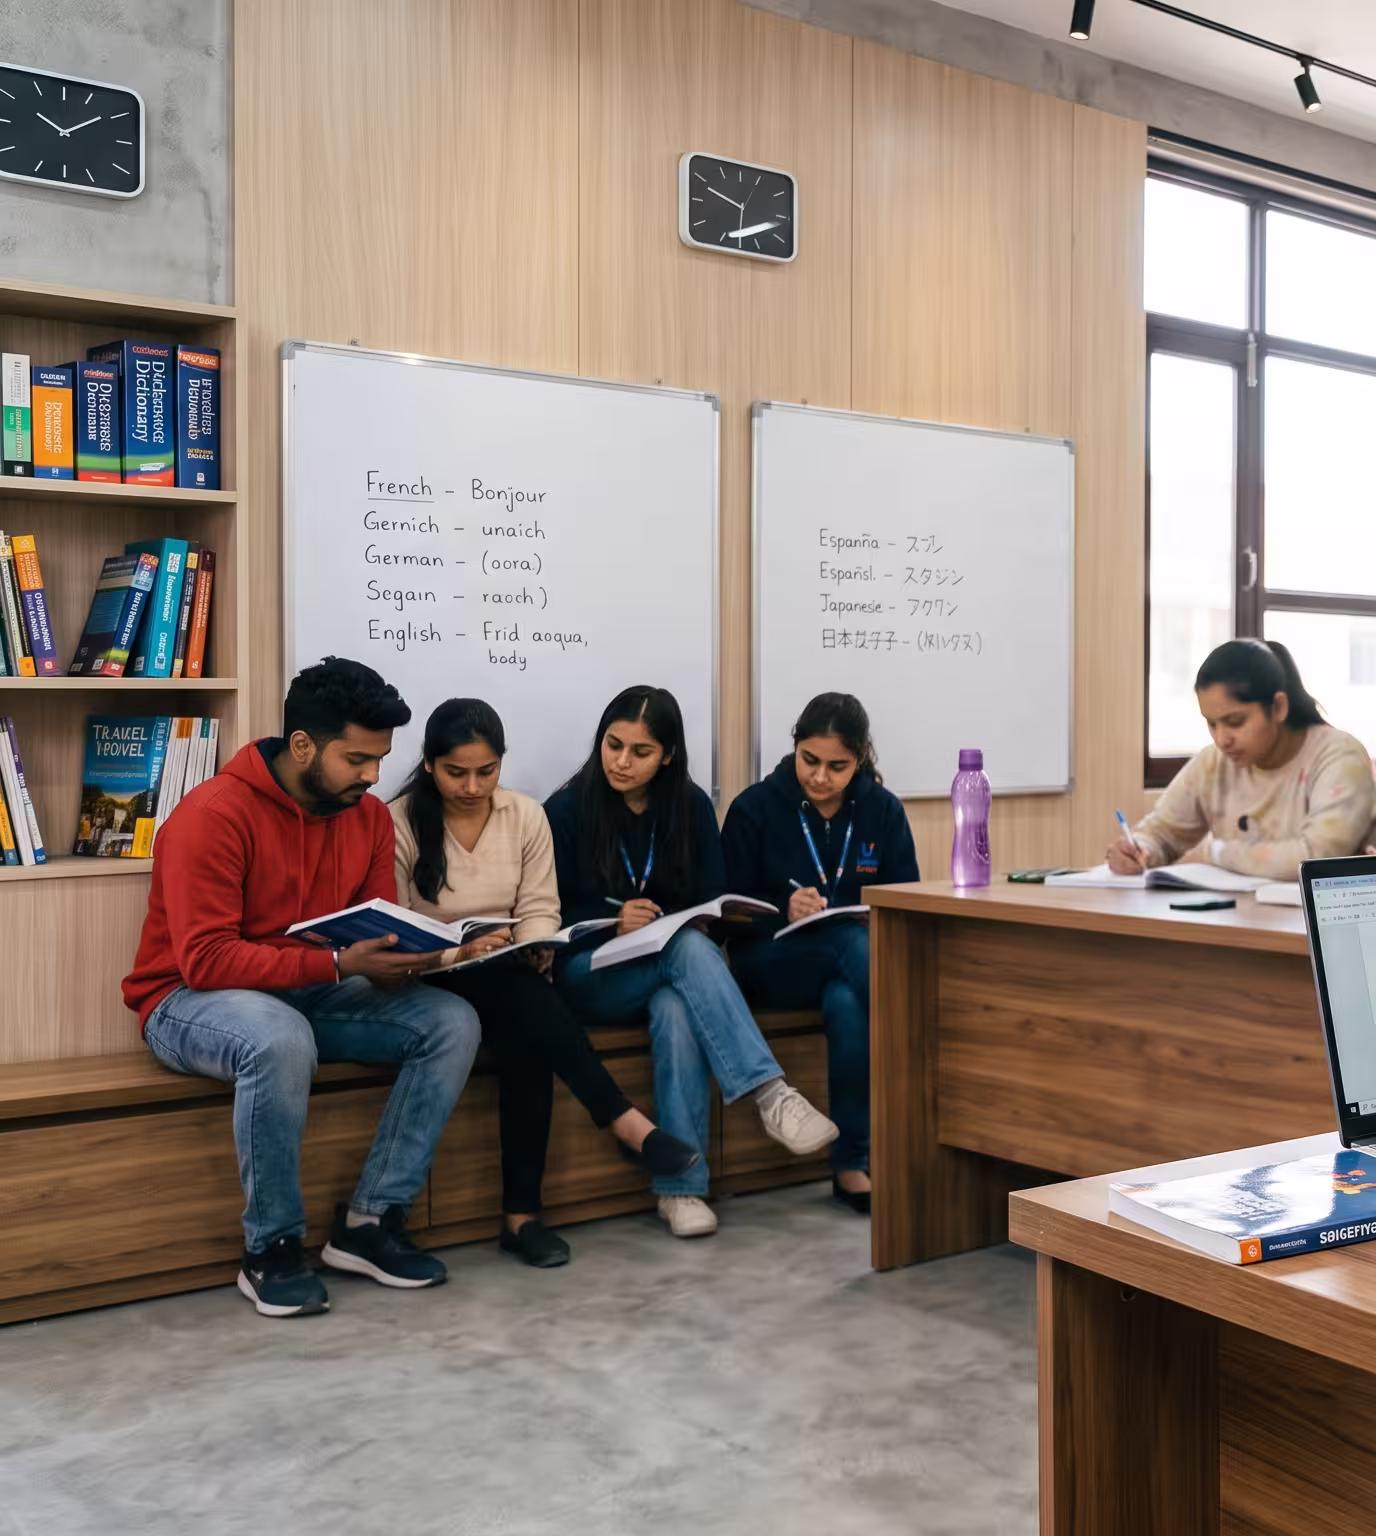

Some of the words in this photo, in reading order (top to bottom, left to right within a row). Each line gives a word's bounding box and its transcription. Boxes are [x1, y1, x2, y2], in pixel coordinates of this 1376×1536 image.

[367, 470, 432, 496] French
[471, 478, 546, 512] Bonjour
[363, 510, 440, 534] Gernich
[482, 520, 546, 540] unaich
[364, 544, 444, 567] German
[366, 580, 436, 611] Segain
[368, 620, 442, 651] English
[483, 621, 520, 643] Frid
[489, 648, 527, 671] body
